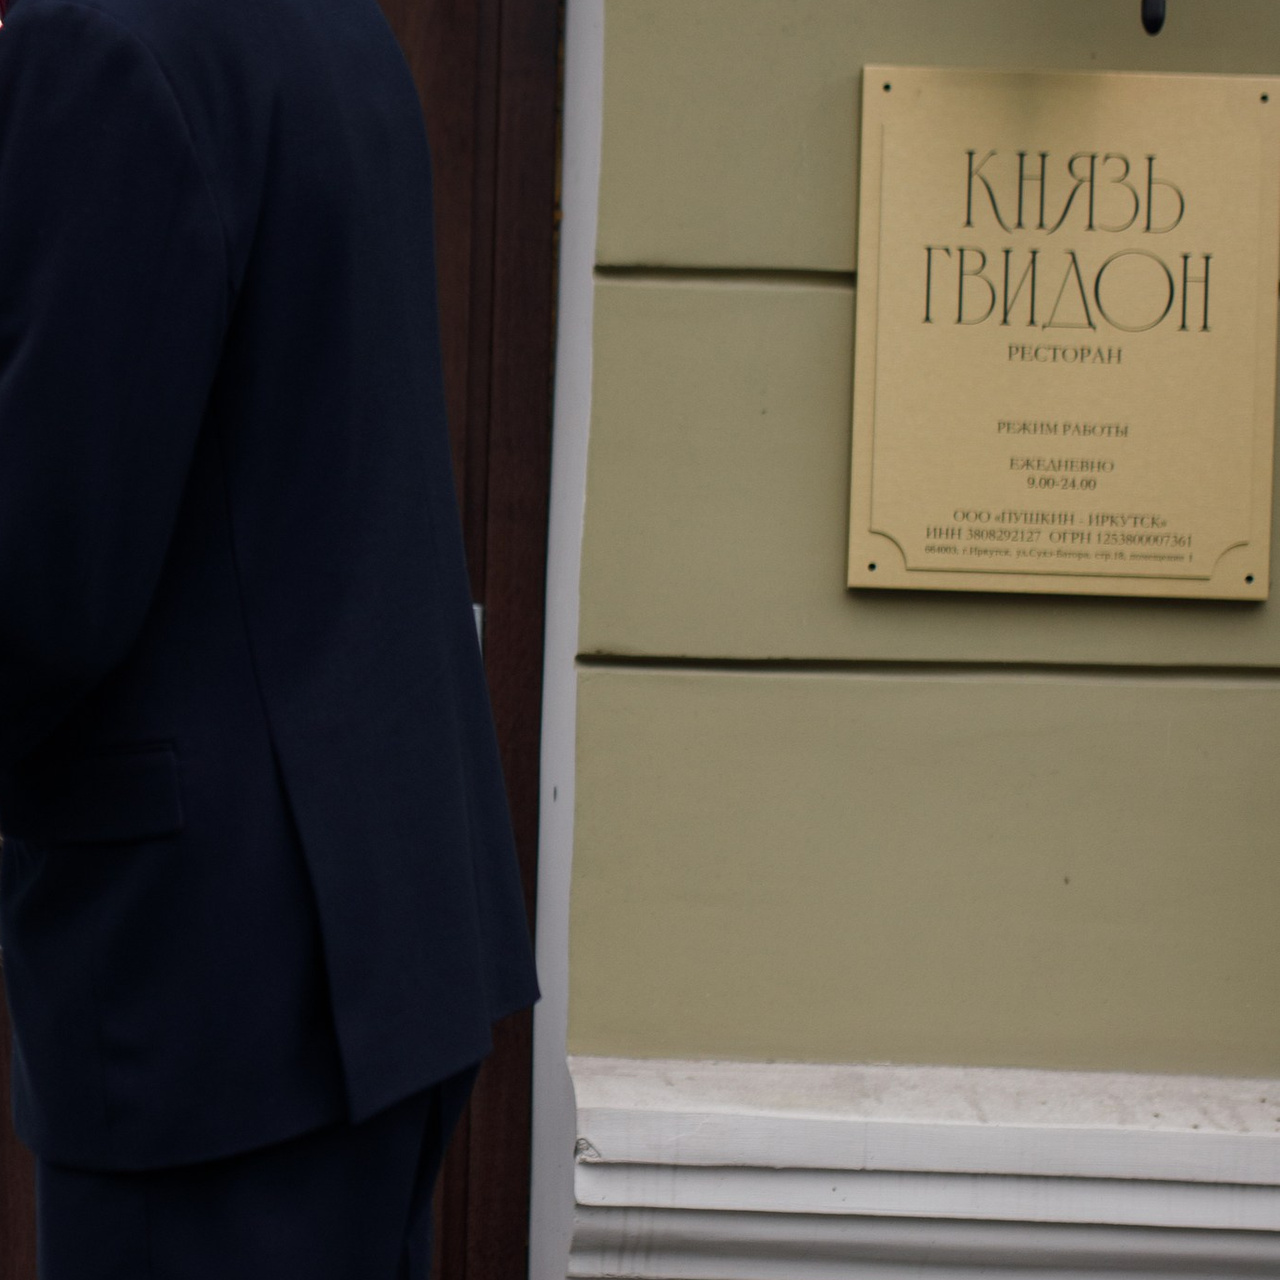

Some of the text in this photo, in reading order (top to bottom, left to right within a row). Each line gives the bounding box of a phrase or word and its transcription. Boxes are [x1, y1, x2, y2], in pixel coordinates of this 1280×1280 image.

[964, 149, 1185, 235] КНЯЗЬ
[922, 244, 1213, 333] ГВИДОН
[1007, 343, 1122, 366] РЕСТОРАН
[997, 421, 1129, 438] РЕЖИМ РАБОТЫ
[1009, 457, 1115, 473] ЕЖЕДНЕВНО
[1027, 476, 1098, 491] 9.00-24.00
[953, 510, 991, 524] ООО
[926, 526, 962, 540] ИНН
[966, 528, 1041, 542] 3808292127
[1049, 531, 1091, 545] ОГРН
